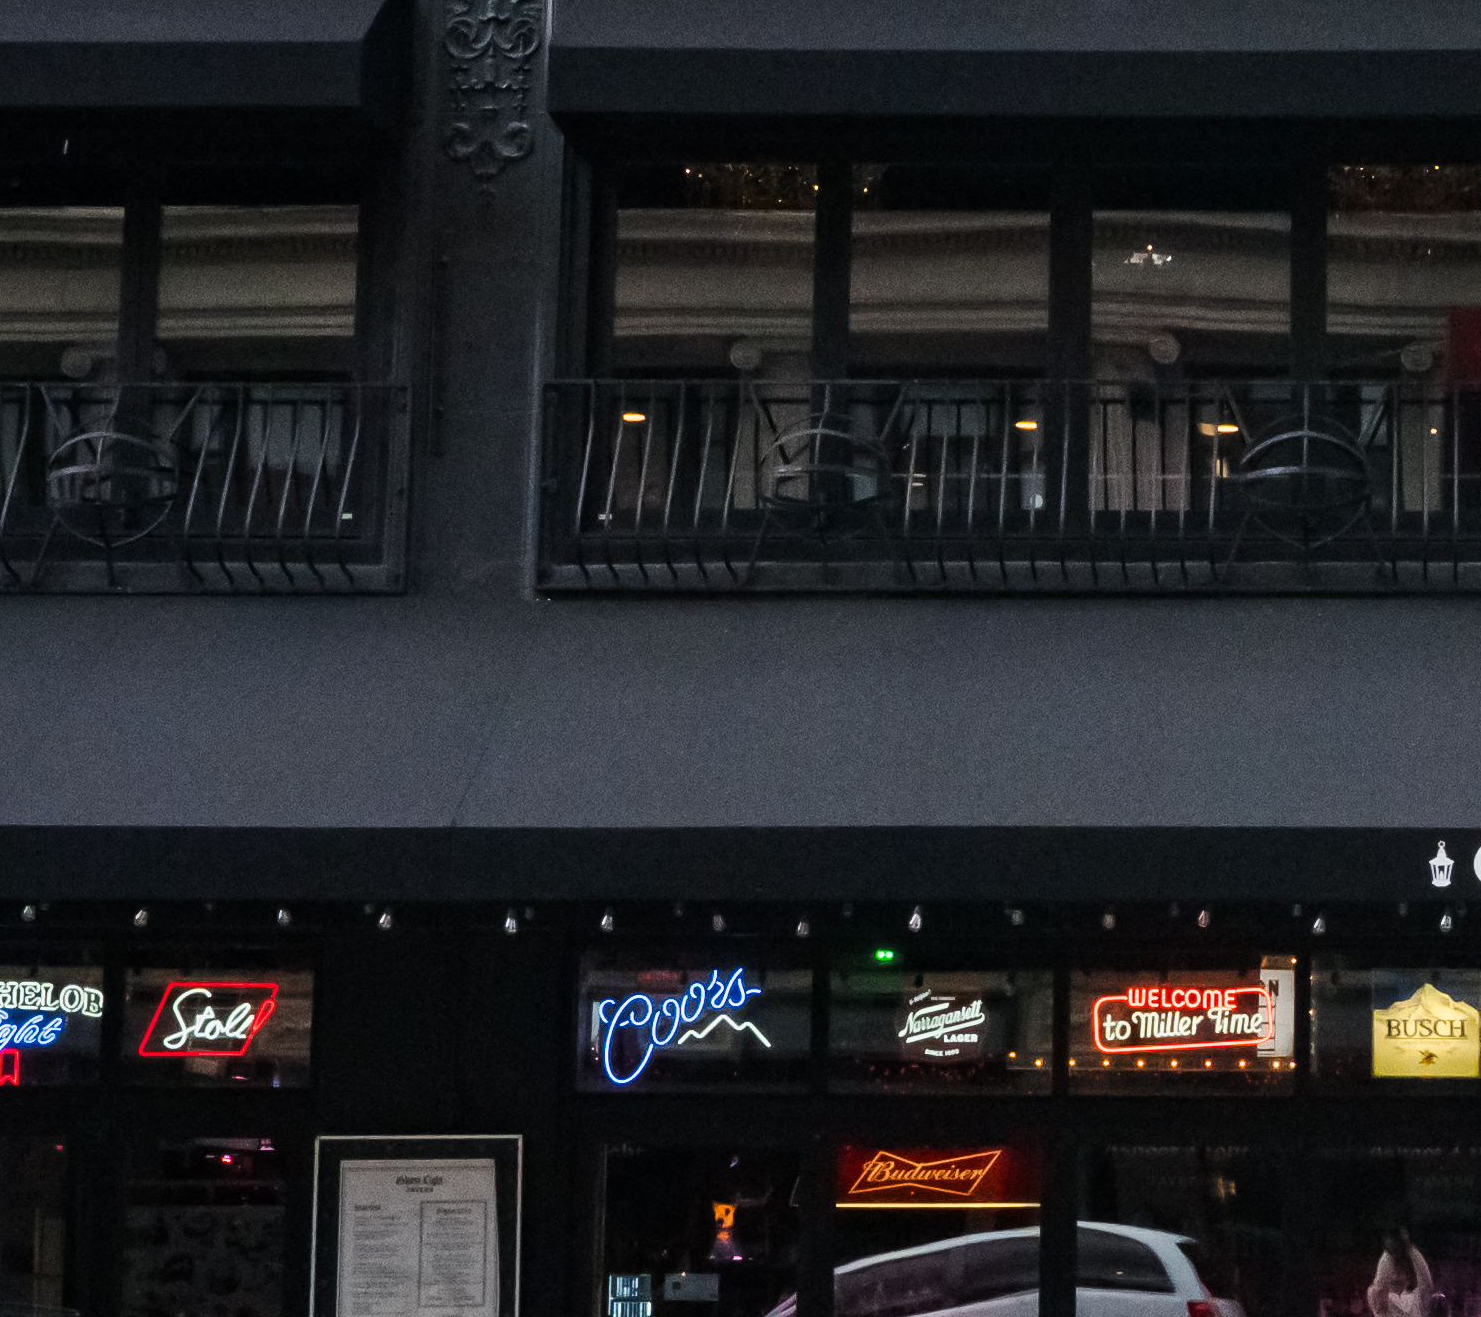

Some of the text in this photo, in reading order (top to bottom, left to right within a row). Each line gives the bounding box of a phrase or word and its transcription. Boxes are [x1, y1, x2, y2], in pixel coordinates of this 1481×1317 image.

[1127, 987, 1238, 1009] WELCOME
[600, 968, 762, 1084] Coors
[898, 999, 985, 1040] Narragansett
[1103, 1007, 1263, 1041] to Miller Time
[1385, 1018, 1467, 1039] BUSCH
[944, 1034, 978, 1043] LAGER
[863, 1160, 985, 1182] Budweiser
